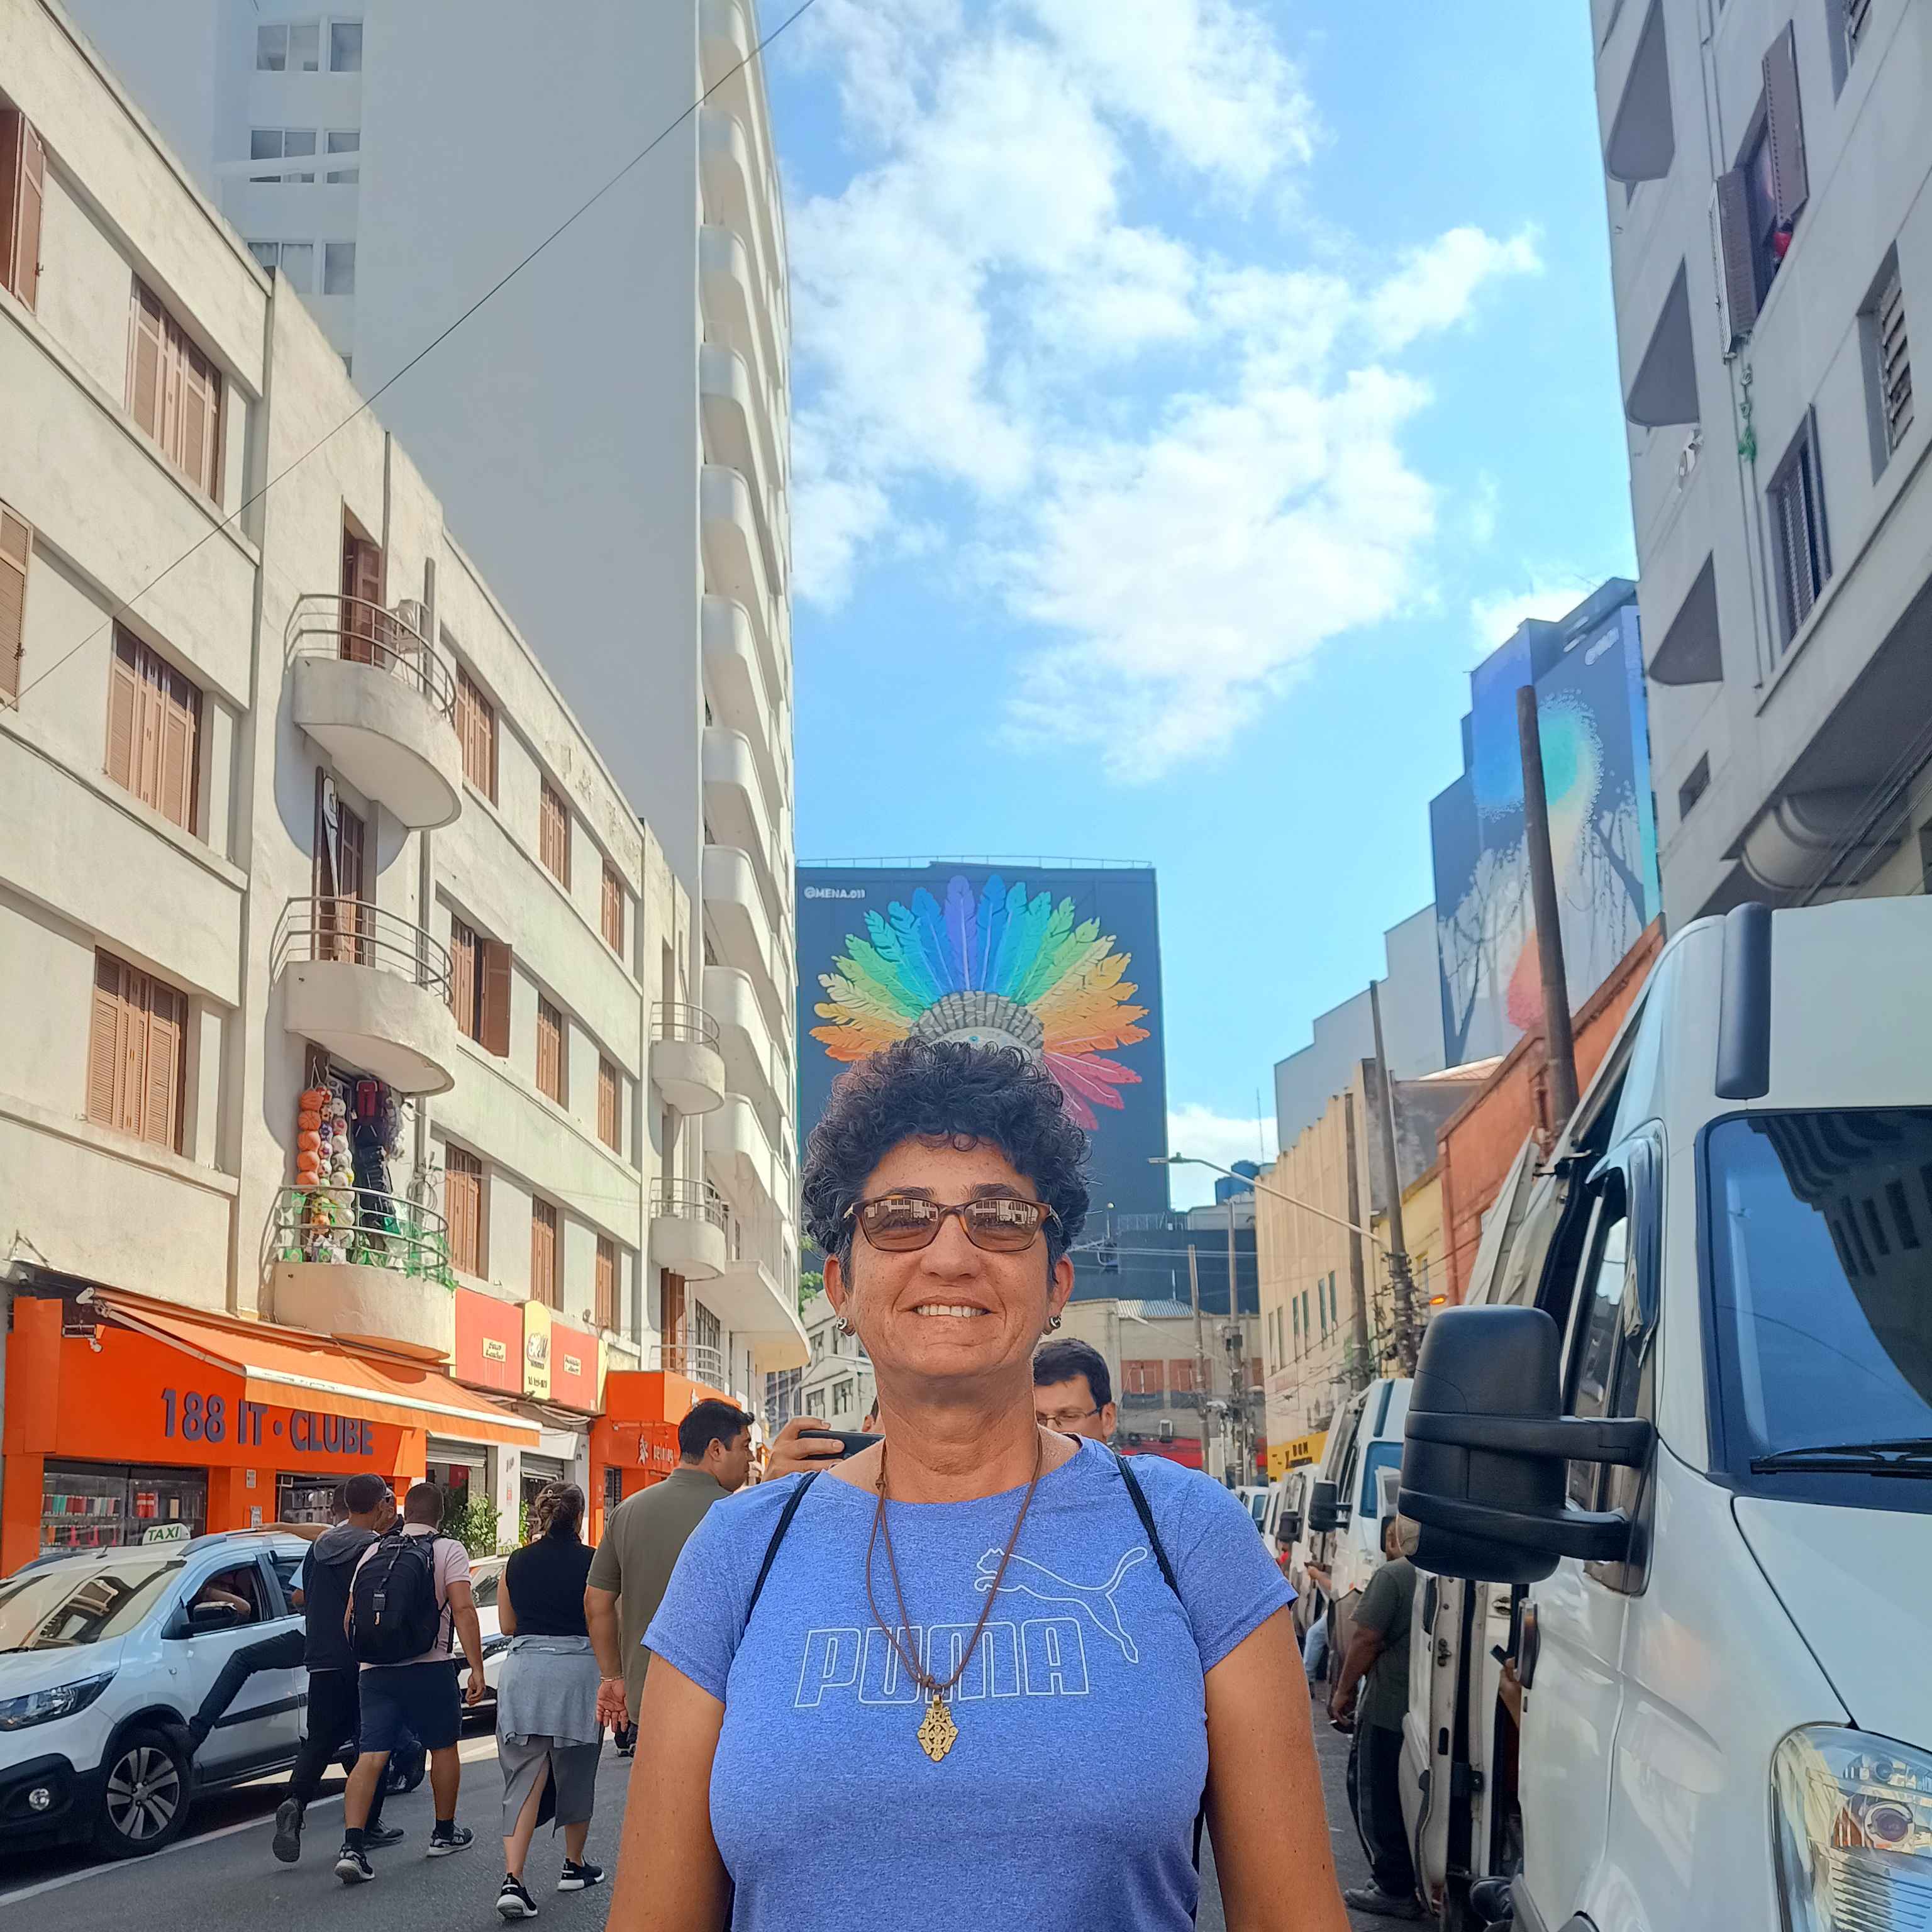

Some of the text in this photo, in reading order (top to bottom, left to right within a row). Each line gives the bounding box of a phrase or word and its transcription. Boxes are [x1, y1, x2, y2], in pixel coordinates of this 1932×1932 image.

[804, 887, 865, 899] @MENA.011
[162, 1387, 374, 1456] 188 IT CLUBE
[148, 1526, 179, 1541] TAXI
[794, 1616, 1090, 1708] PUMA
